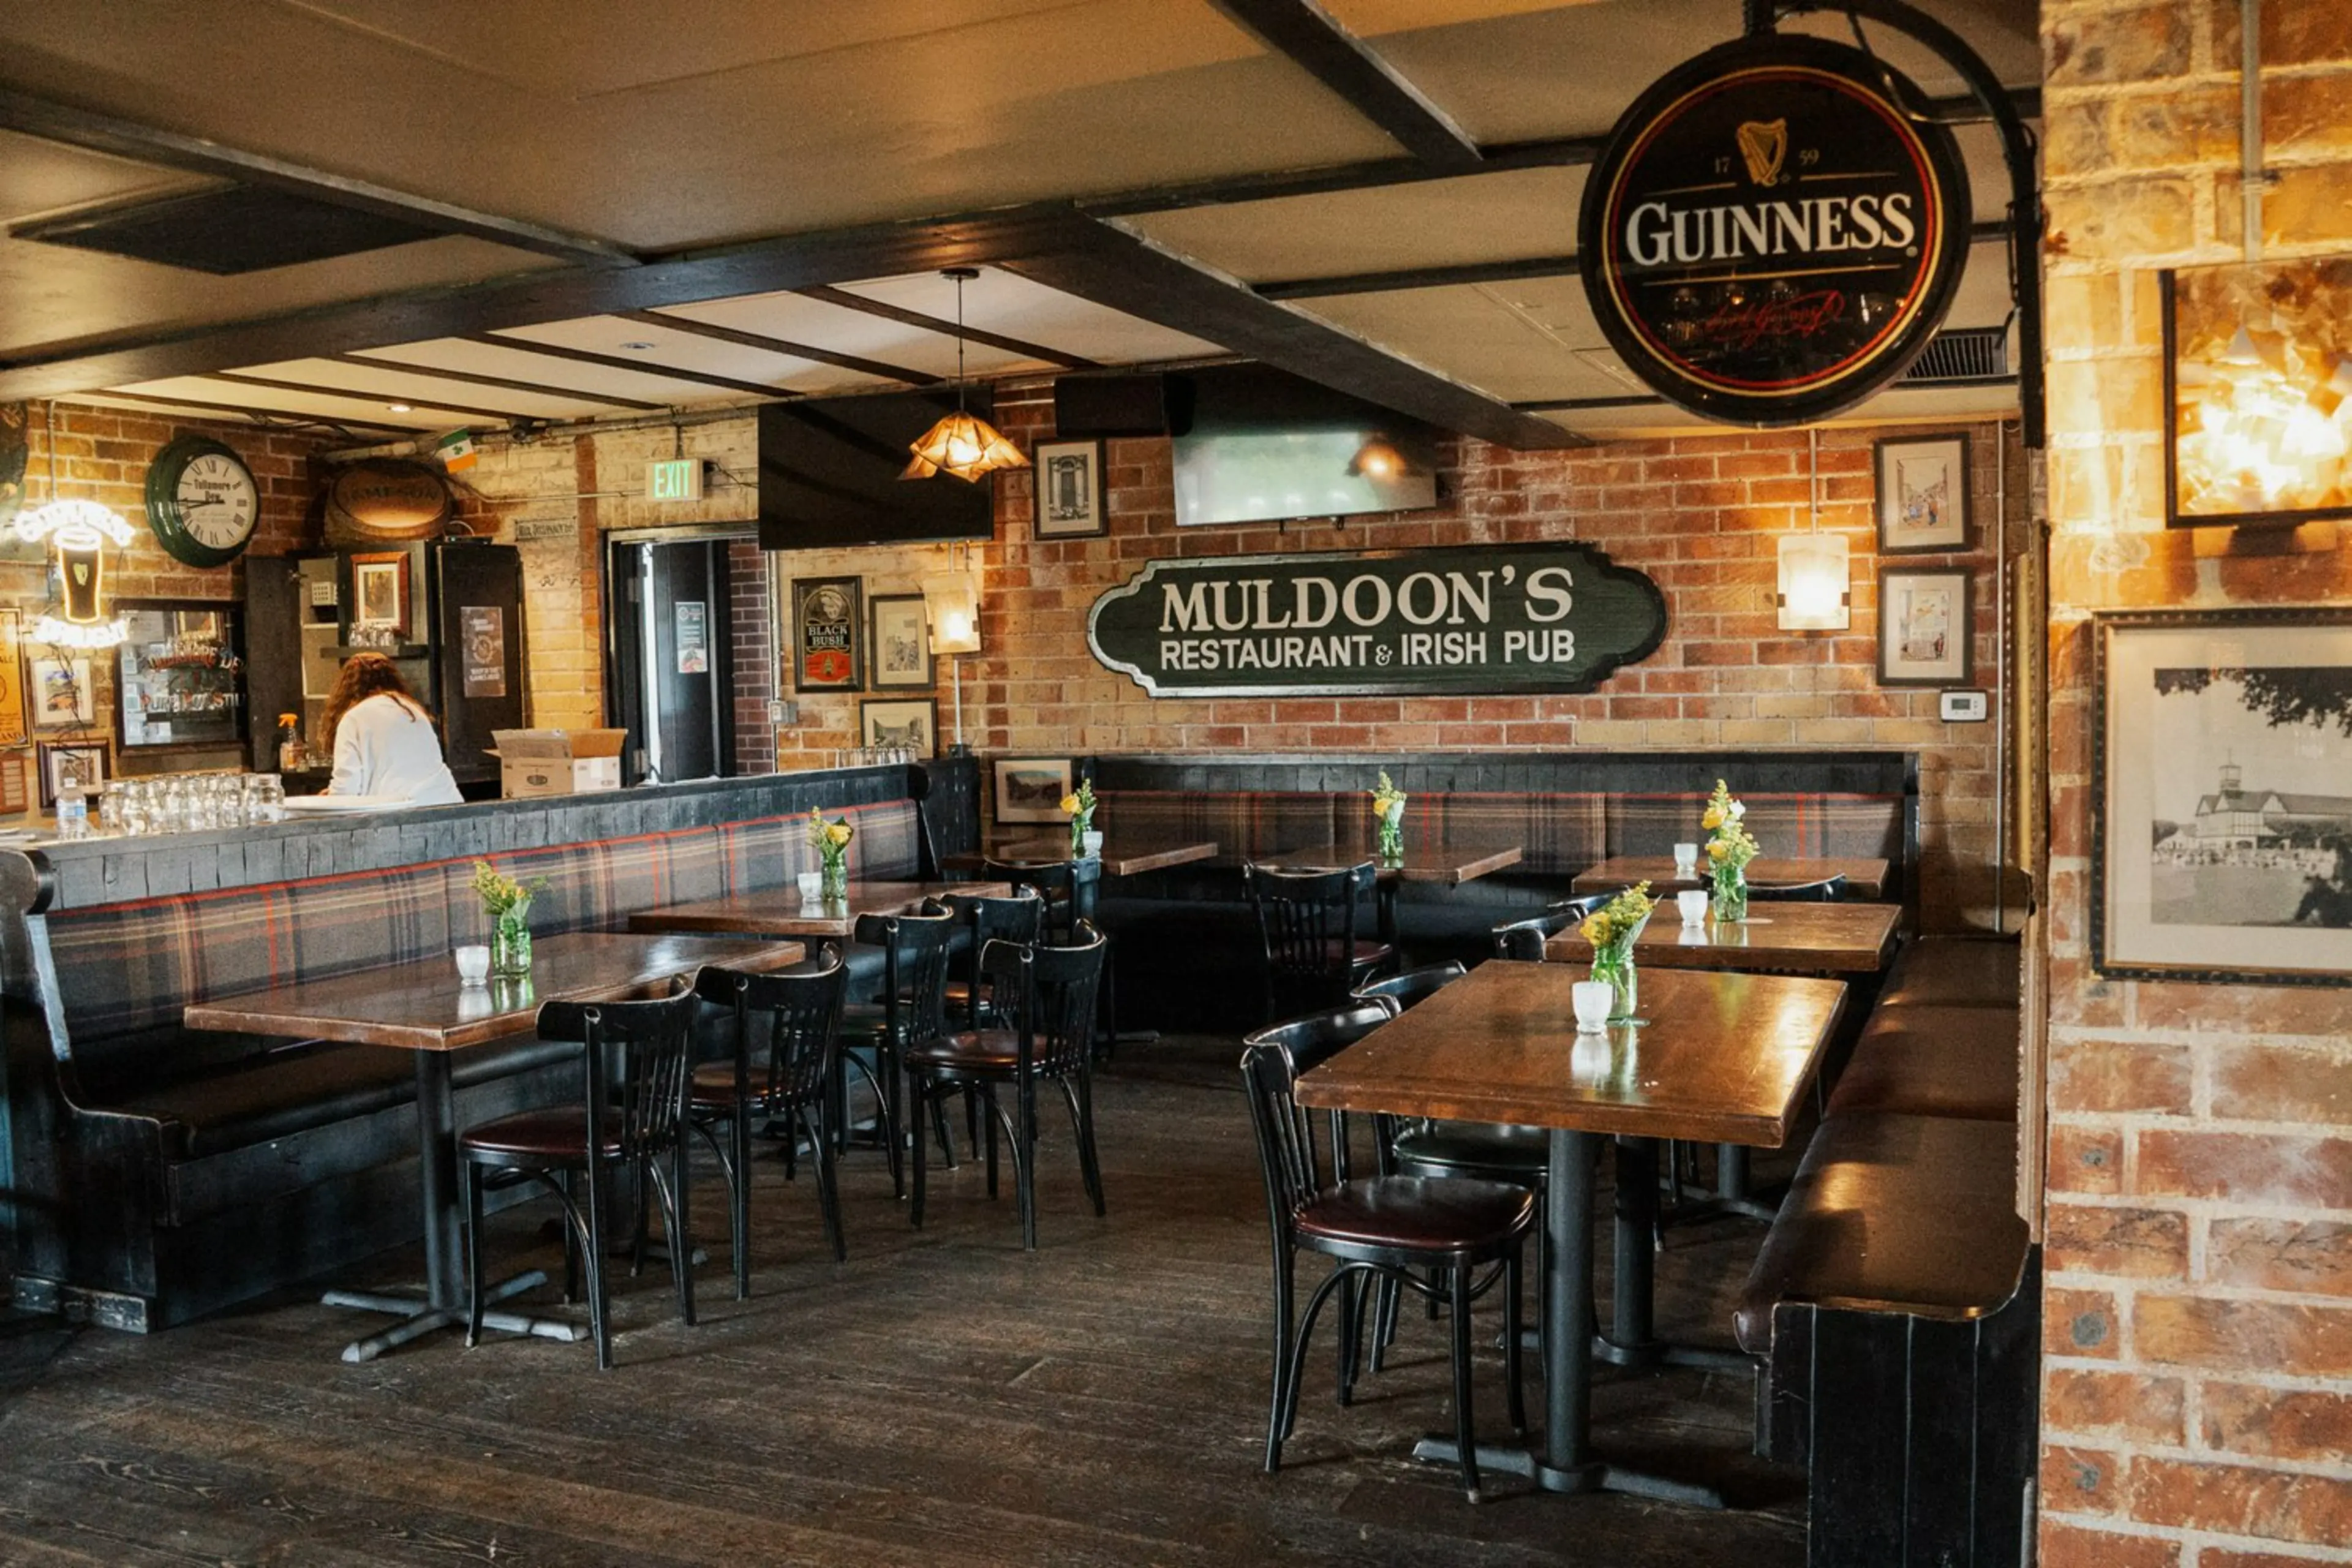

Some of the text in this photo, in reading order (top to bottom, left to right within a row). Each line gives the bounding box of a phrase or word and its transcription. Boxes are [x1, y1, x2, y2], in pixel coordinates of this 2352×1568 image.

[1714, 149, 1820, 175] 17 59
[1626, 193, 1915, 266] GUINNESS
[654, 461, 692, 499] EXIT
[1158, 565, 1574, 632] MULDOON'S
[809, 625, 848, 636] BLACK
[812, 635, 844, 646] BUSH
[1161, 630, 1575, 671] RESTAURANT & IRISH PUB
